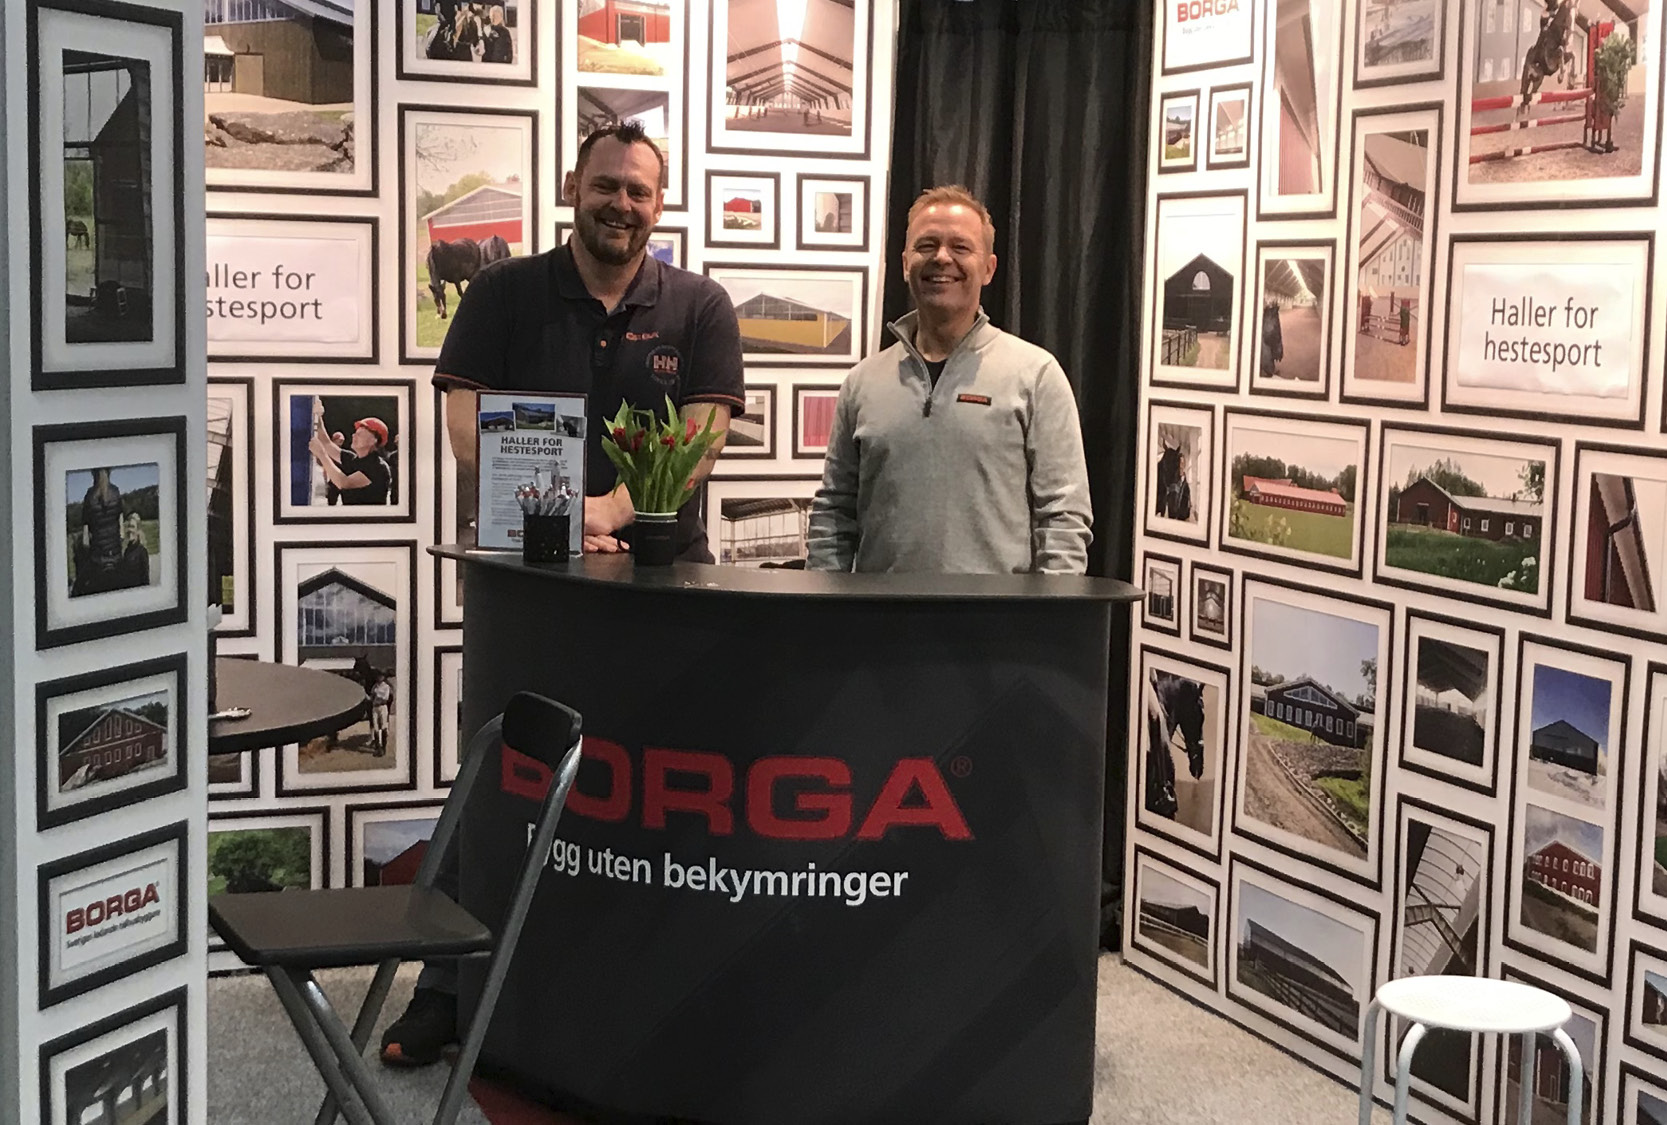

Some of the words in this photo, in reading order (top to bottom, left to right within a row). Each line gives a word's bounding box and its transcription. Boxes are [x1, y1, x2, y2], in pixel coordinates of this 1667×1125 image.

[1177, 0, 1240, 23] BORGA
[272, 264, 316, 290] for
[1491, 296, 1557, 327] Haller
[1564, 297, 1598, 329] for
[1484, 331, 1602, 373] hestesport
[500, 445, 564, 456] HESTESPORT
[501, 436, 539, 446] HALLER
[542, 437, 563, 447] FOR
[587, 847, 652, 884] uten
[663, 852, 909, 905] bekymringer
[66, 882, 161, 935] BORGA
